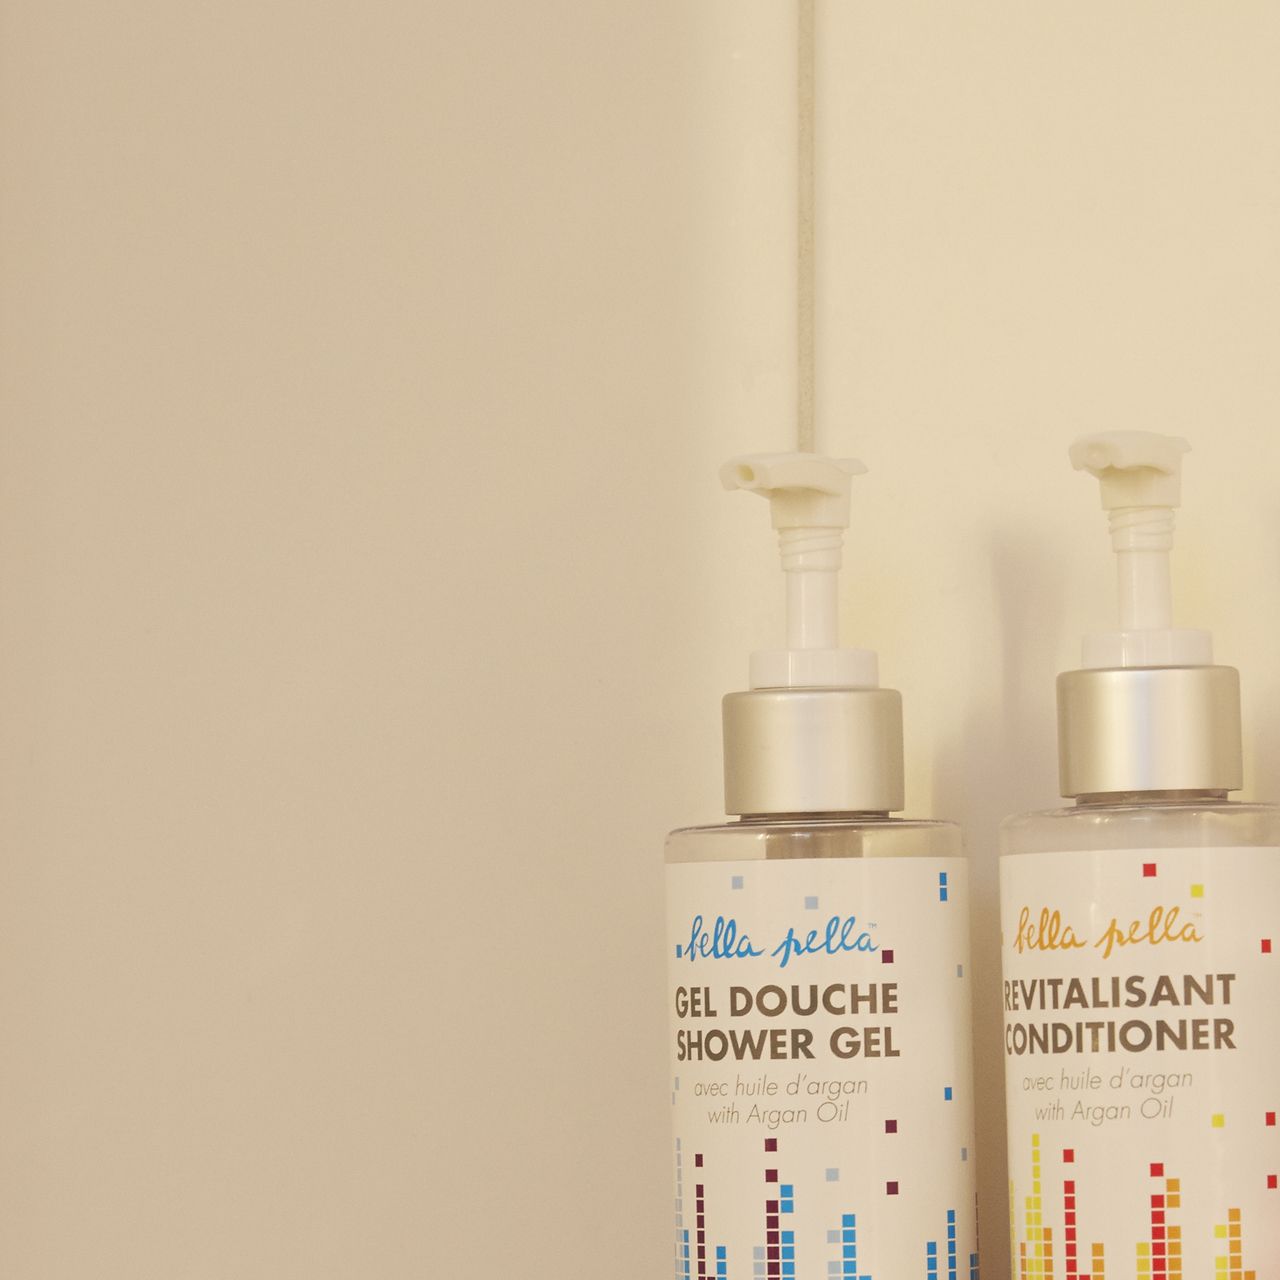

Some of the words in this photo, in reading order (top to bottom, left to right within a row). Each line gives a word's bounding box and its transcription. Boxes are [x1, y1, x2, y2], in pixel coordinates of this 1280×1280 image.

[771, 916, 879, 968] pella
[1094, 906, 1205, 959] pella
[676, 987, 717, 1018] GEL
[730, 983, 898, 1017] DOUCHE
[1004, 974, 1236, 1011] REVITALISANT
[677, 1029, 816, 1061] SHOWER
[829, 1027, 900, 1059] GEL
[1005, 1018, 1237, 1055] CONDITIONER
[694, 1079, 728, 1097] avec
[735, 1074, 778, 1096] huile
[787, 1074, 868, 1100] d'argan
[1023, 1075, 1053, 1091] avec
[1060, 1068, 1102, 1090] huile
[1110, 1067, 1192, 1094] d'argan
[708, 1103, 739, 1124] with
[746, 1104, 807, 1130] Argan
[817, 1101, 850, 1123] Oil
[1035, 1098, 1064, 1120] with
[1071, 1100, 1131, 1126] Argan
[1140, 1096, 1173, 1119] Oil
